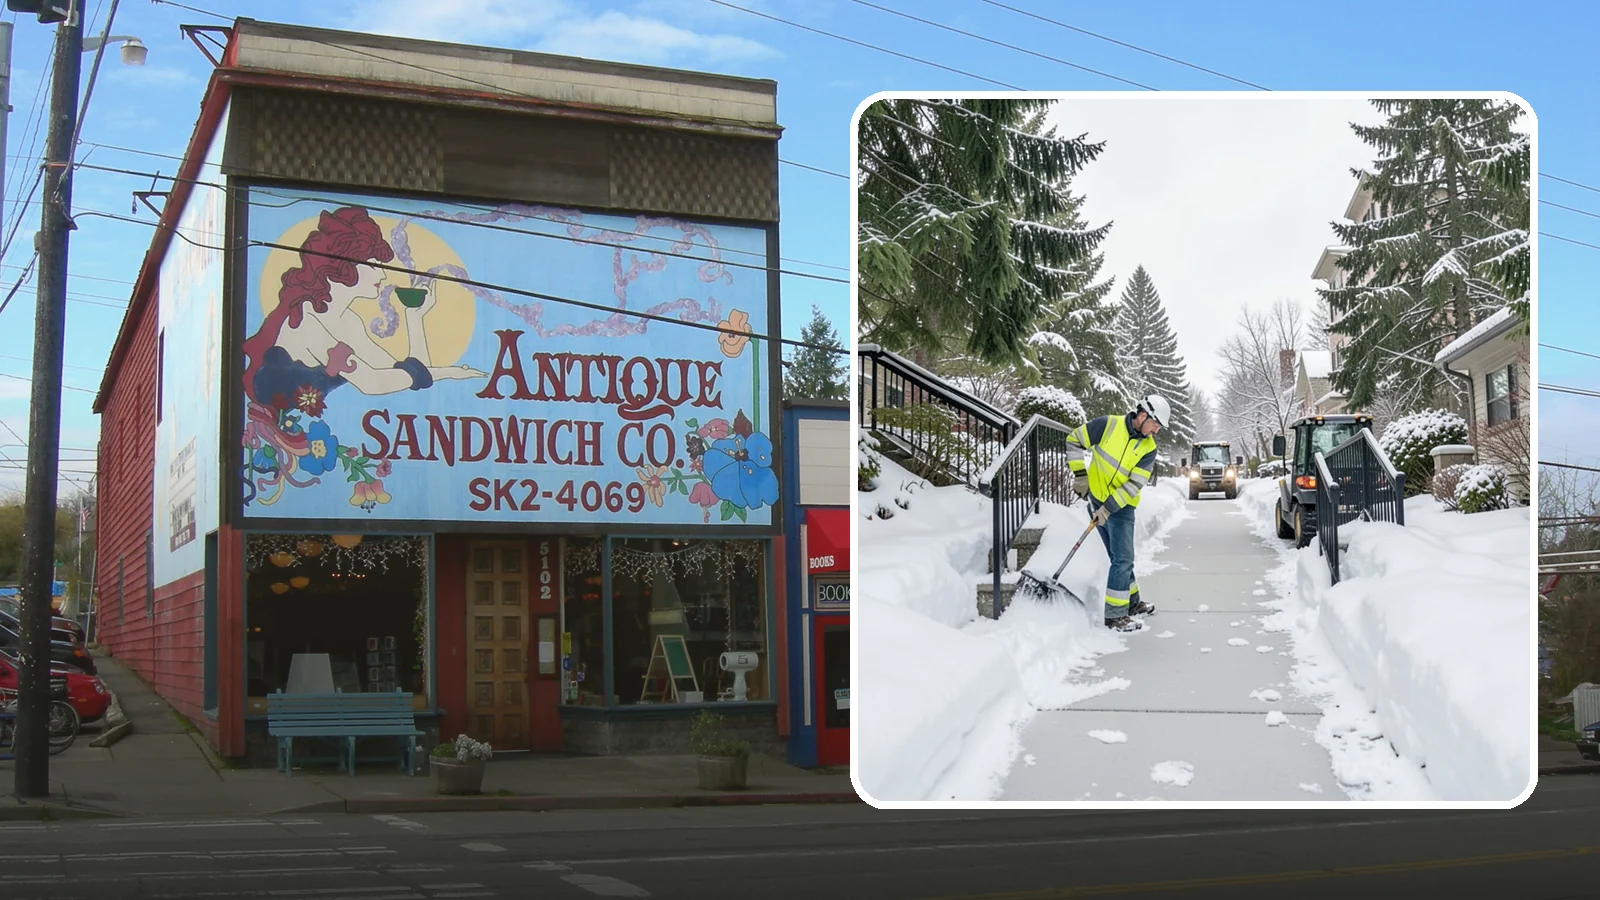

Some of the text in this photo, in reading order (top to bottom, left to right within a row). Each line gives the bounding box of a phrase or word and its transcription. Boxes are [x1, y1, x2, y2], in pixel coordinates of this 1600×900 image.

[477, 329, 723, 420] ANTIQUE
[361, 408, 685, 469] SANDWICH CO.
[468, 478, 646, 513] SK2-4069
[540, 542, 551, 599] 5102
[809, 555, 834, 568] BOOKS
